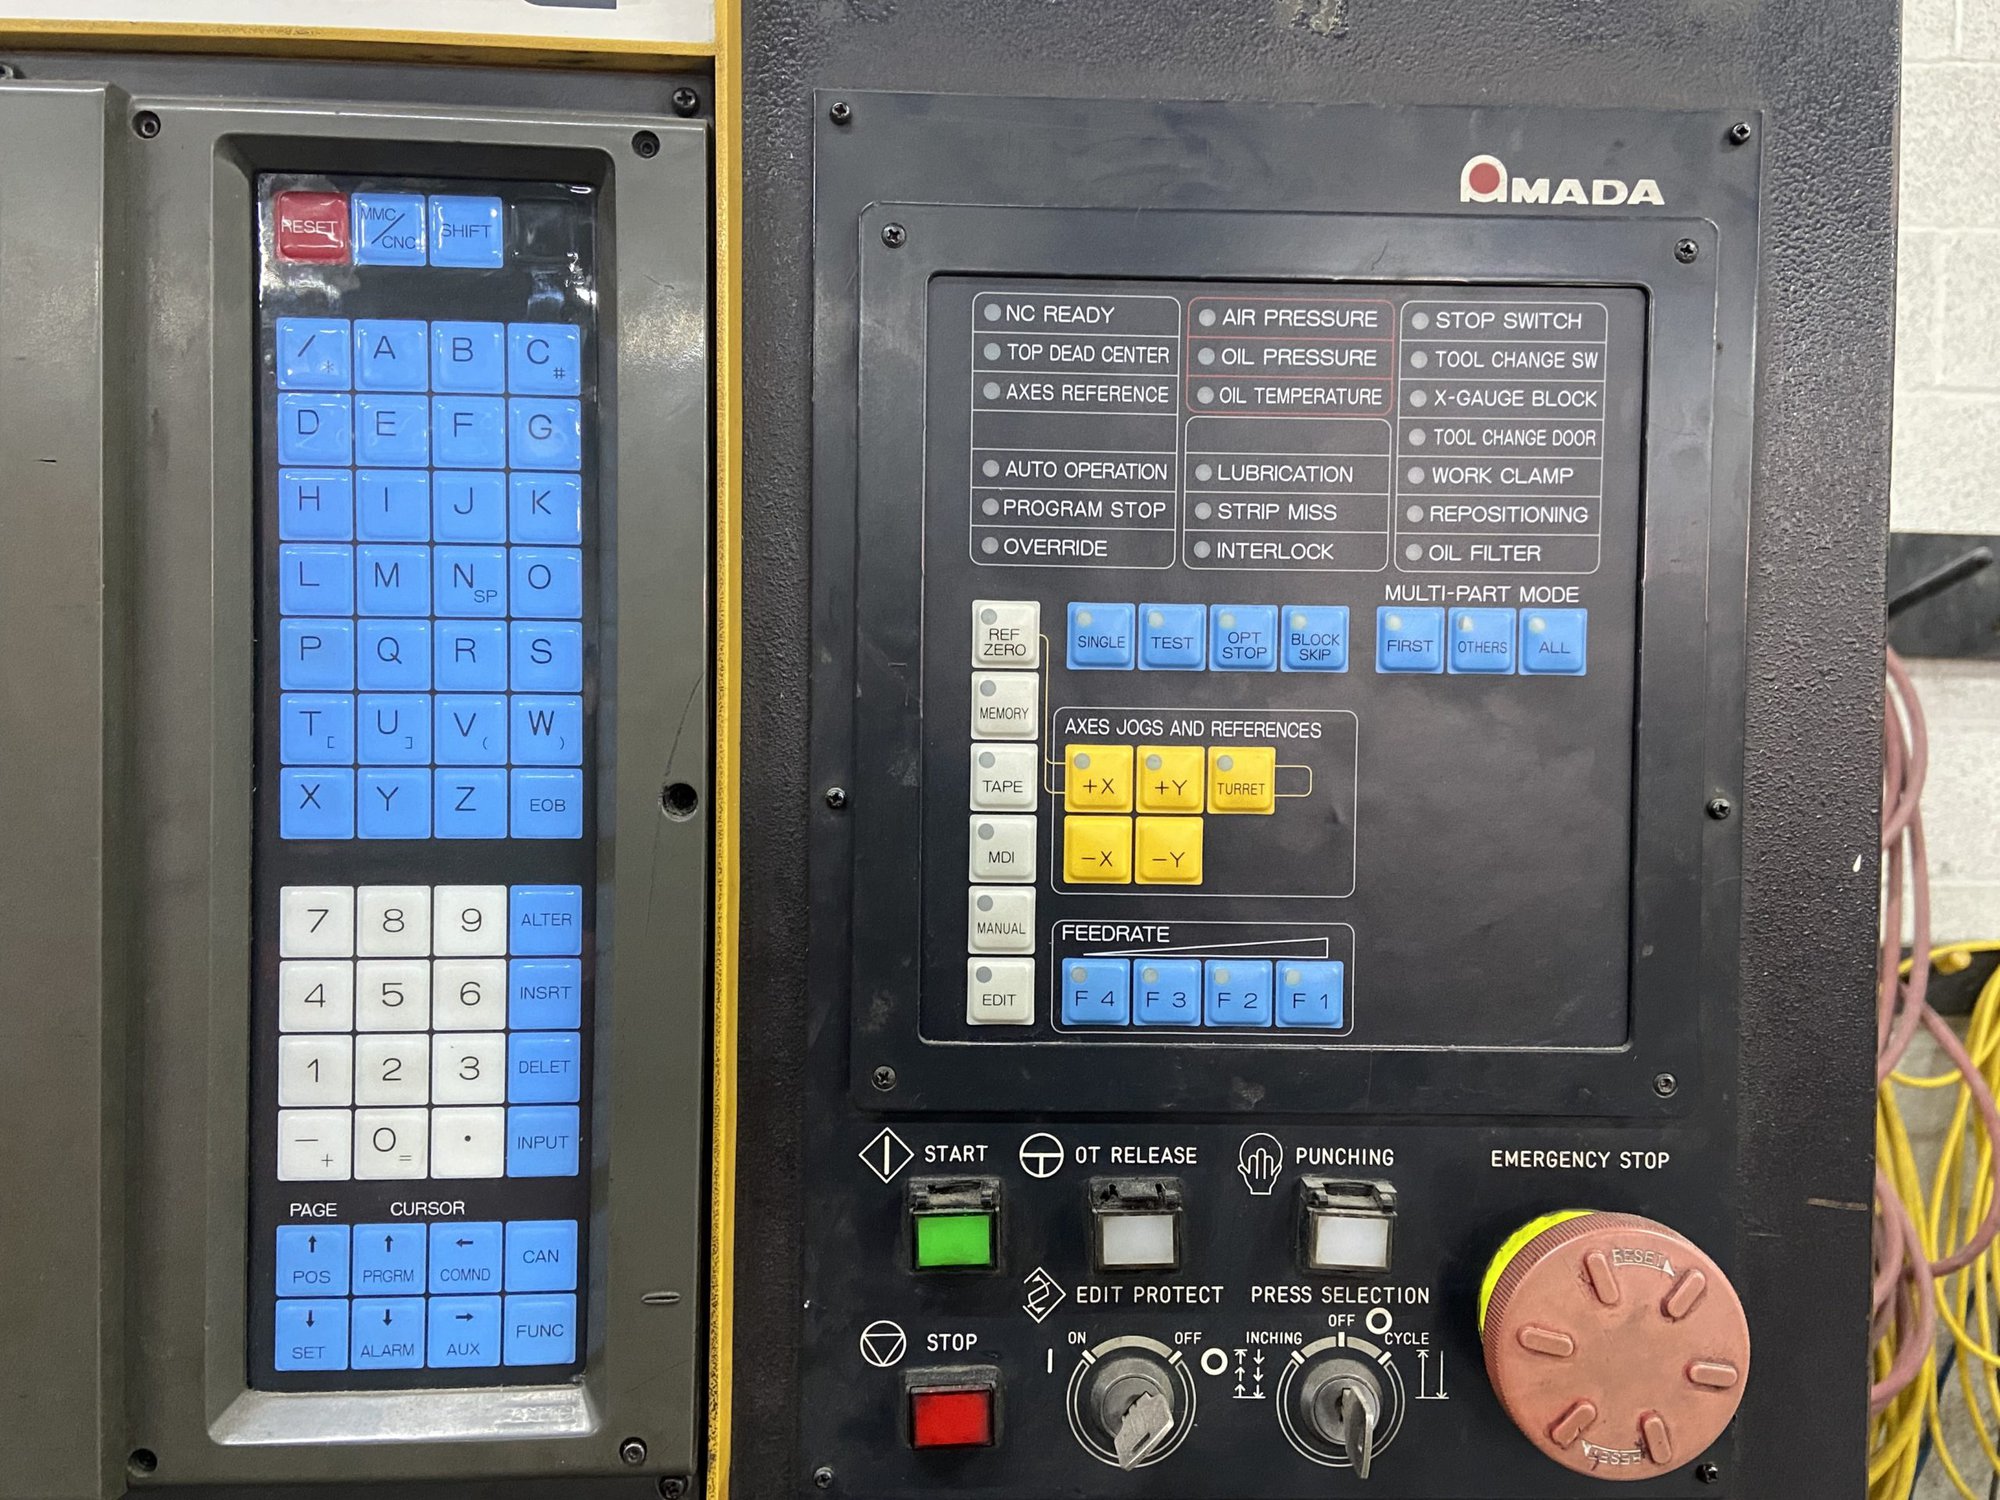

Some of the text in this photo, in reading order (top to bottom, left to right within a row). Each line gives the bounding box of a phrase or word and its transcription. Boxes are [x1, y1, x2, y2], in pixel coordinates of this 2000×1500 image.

[1459, 154, 1666, 206] AMADA
[360, 207, 396, 221] MMC
[281, 220, 338, 234] RESET
[441, 224, 492, 239] SHIFT
[381, 235, 416, 249] CNC
[1005, 305, 1115, 324] NC READY
[1222, 308, 1378, 328] AIR PRESSURE
[1436, 311, 1582, 330] STOP SWITCH
[373, 335, 396, 360] A
[452, 337, 474, 362] B
[526, 339, 550, 364] C
[1007, 343, 1170, 364] TOP DEAD CENTER
[1221, 348, 1377, 367] OIL PRESSURE
[1435, 350, 1599, 369] TOOL CHANGE SW
[1006, 383, 1169, 403] AXES REFERENCE
[1219, 386, 1382, 405] OIL TEMPERATURE
[1434, 389, 1598, 407] X-GAUGE BLOCK
[297, 409, 320, 435] D
[376, 411, 397, 437] E
[454, 412, 474, 437] F
[528, 414, 552, 440] G
[1434, 428, 1597, 447] TOOL CHANGE DOOR
[1005, 460, 1168, 481] AUTO OPERATION
[1217, 465, 1353, 483] LUBRICATION
[1432, 466, 1574, 485] WORK CLAMP
[298, 485, 320, 511] H
[384, 486, 389, 512] I
[453, 487, 474, 515] J
[531, 489, 552, 515] K
[1003, 499, 1167, 519] PROGRAM STOP
[1217, 503, 1337, 521] STRIP MISS
[1430, 505, 1589, 523] REPOSITIONING
[1003, 538, 1108, 557] OVERRIDE
[1217, 542, 1335, 560] INTERLOCK
[1428, 544, 1541, 562] OIL FILTER
[299, 561, 320, 587] L
[374, 562, 399, 588] M
[454, 563, 474, 589] N
[527, 563, 551, 590] O
[473, 590, 498, 603] SP
[1385, 584, 1580, 603] MULTI-PART MODE
[988, 629, 1020, 641] REF
[1077, 635, 1126, 649] SINGLE
[1151, 636, 1194, 650] TEST
[1227, 632, 1262, 644] OPT
[1291, 633, 1340, 646] BLOCK
[300, 636, 322, 661] P
[376, 636, 402, 664] Q
[455, 638, 476, 663] R
[530, 638, 553, 664] S
[983, 643, 1027, 656] ZERO
[1222, 646, 1268, 660] STOP
[1298, 648, 1331, 662] SKIP
[1387, 639, 1434, 654] FIRST
[1457, 640, 1508, 655] OTHERS
[1538, 640, 1571, 655] ALL
[377, 709, 398, 735] U
[528, 710, 555, 736] W
[979, 707, 1030, 720] MEMORY
[299, 711, 322, 736] T
[454, 712, 476, 737] V
[1065, 718, 1322, 739] AXES JOGS AND REFERENCES
[982, 780, 1024, 793] TAPE
[1082, 778, 1115, 794] +X
[1154, 779, 1187, 796] +Y
[1217, 782, 1265, 796] TURRET
[299, 783, 321, 810] X
[376, 786, 399, 811] Y
[454, 786, 477, 812] Z
[529, 798, 566, 812] EOB
[988, 851, 1015, 864] MDI
[307, 908, 330, 934] 7
[382, 908, 405, 933] 8
[461, 908, 482, 932] 9
[520, 913, 573, 927] ALTER
[977, 921, 1026, 935] MANUAL
[1061, 924, 1171, 943] FEEDRATE
[304, 983, 326, 1008] 4
[381, 982, 404, 1007] 5
[459, 981, 481, 1006] 6
[520, 986, 573, 1000] INSRT
[982, 993, 1017, 1007] EDIT
[307, 1058, 319, 1083] 1
[382, 1057, 402, 1081] 2
[459, 1056, 480, 1080] 3
[518, 1060, 571, 1074] DELET
[517, 1135, 570, 1150] INPUT
[924, 1145, 989, 1163] START
[1074, 1146, 1198, 1164] OT RELEASE
[1296, 1147, 1394, 1167] PUNCHING
[1491, 1150, 1671, 1170] EMERGENCY STOP
[290, 1203, 338, 1218] PAGE
[390, 1200, 465, 1217] CURSOR
[522, 1249, 559, 1264] CAN
[1611, 1248, 1665, 1267] RESET
[293, 1270, 331, 1284] POS
[362, 1270, 415, 1283] PRGRM
[440, 1268, 491, 1282] COMND
[1075, 1286, 1224, 1304] EDIT PROTECT
[1250, 1286, 1430, 1305] PRESS SELECTION
[1327, 1313, 1356, 1328] OFF
[516, 1324, 564, 1339] FUNC
[1067, 1331, 1087, 1345] ON
[1174, 1332, 1202, 1346] OFF
[1245, 1331, 1302, 1345] INCHING
[1384, 1331, 1430, 1346] CYCLE
[360, 1344, 415, 1358] ALARM
[446, 1343, 480, 1356] AUX
[926, 1333, 978, 1352] STOP
[292, 1346, 326, 1359] SET
